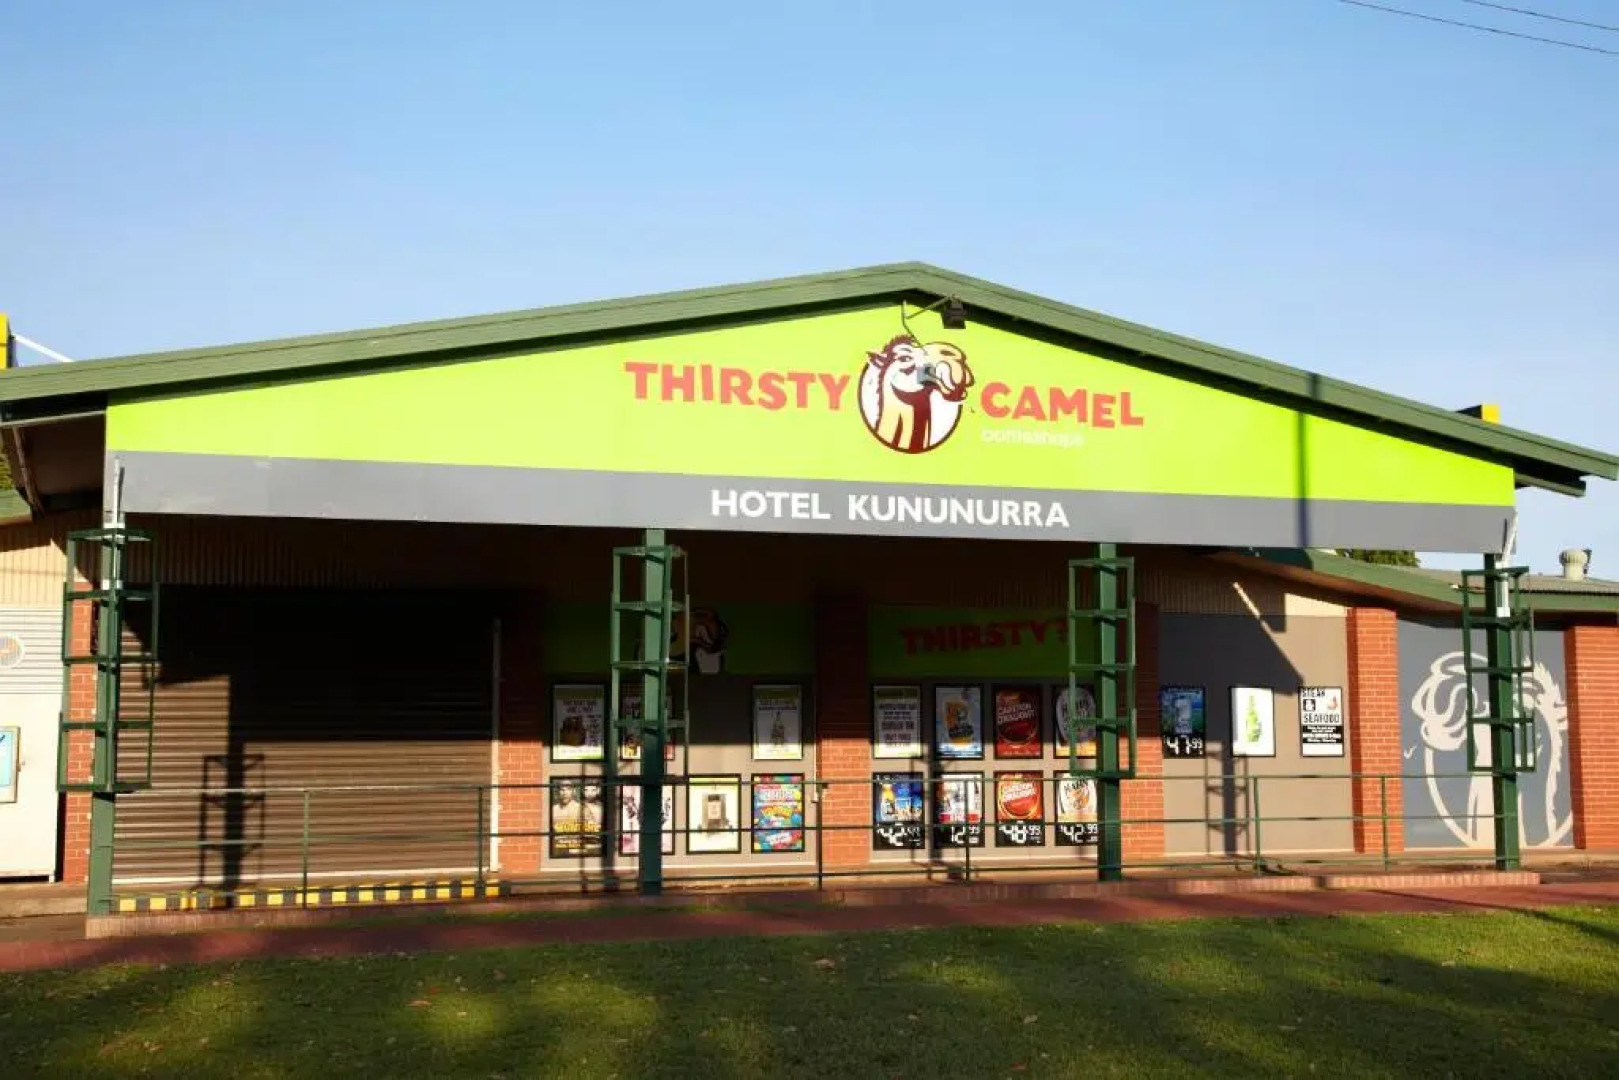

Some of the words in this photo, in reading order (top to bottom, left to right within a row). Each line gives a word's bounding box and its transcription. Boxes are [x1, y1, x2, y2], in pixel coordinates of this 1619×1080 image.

[624, 361, 850, 411] THIRSTY
[981, 382, 1145, 428] CAMEL
[711, 488, 831, 521] HOTEL
[847, 494, 1070, 528] KUNUNURRA
